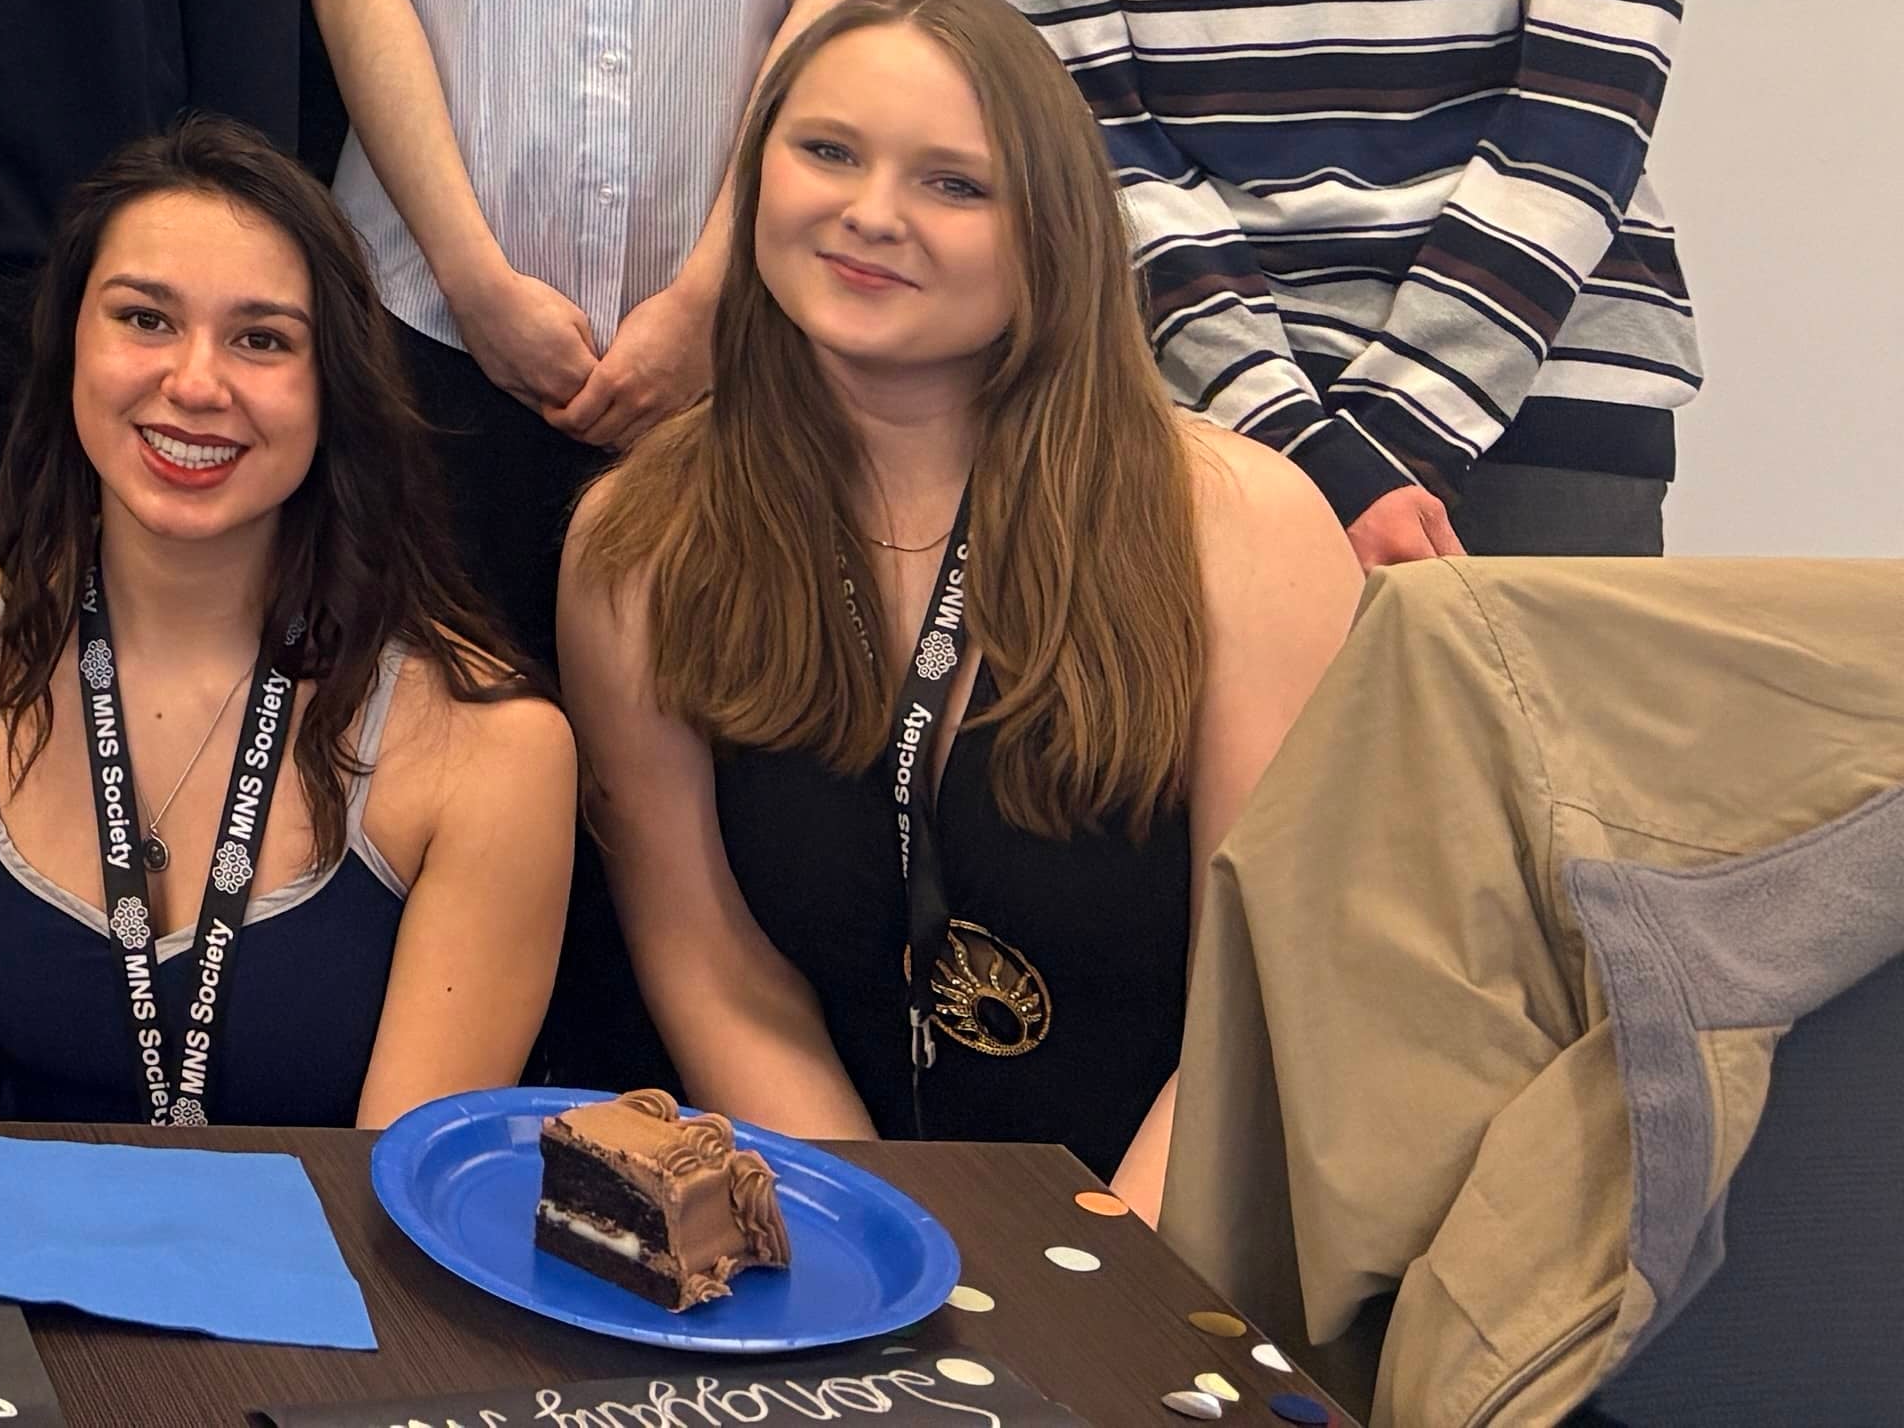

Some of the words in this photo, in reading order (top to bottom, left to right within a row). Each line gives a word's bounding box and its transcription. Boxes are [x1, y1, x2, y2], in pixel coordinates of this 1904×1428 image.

[92, 693, 120, 759] MNS
[228, 775, 264, 841] MNS
[246, 666, 292, 770] Society
[894, 701, 933, 807] Society
[101, 763, 131, 872] Society
[123, 953, 156, 1022] MNS
[190, 917, 235, 1024] Society
[180, 1029, 211, 1096] MNS
